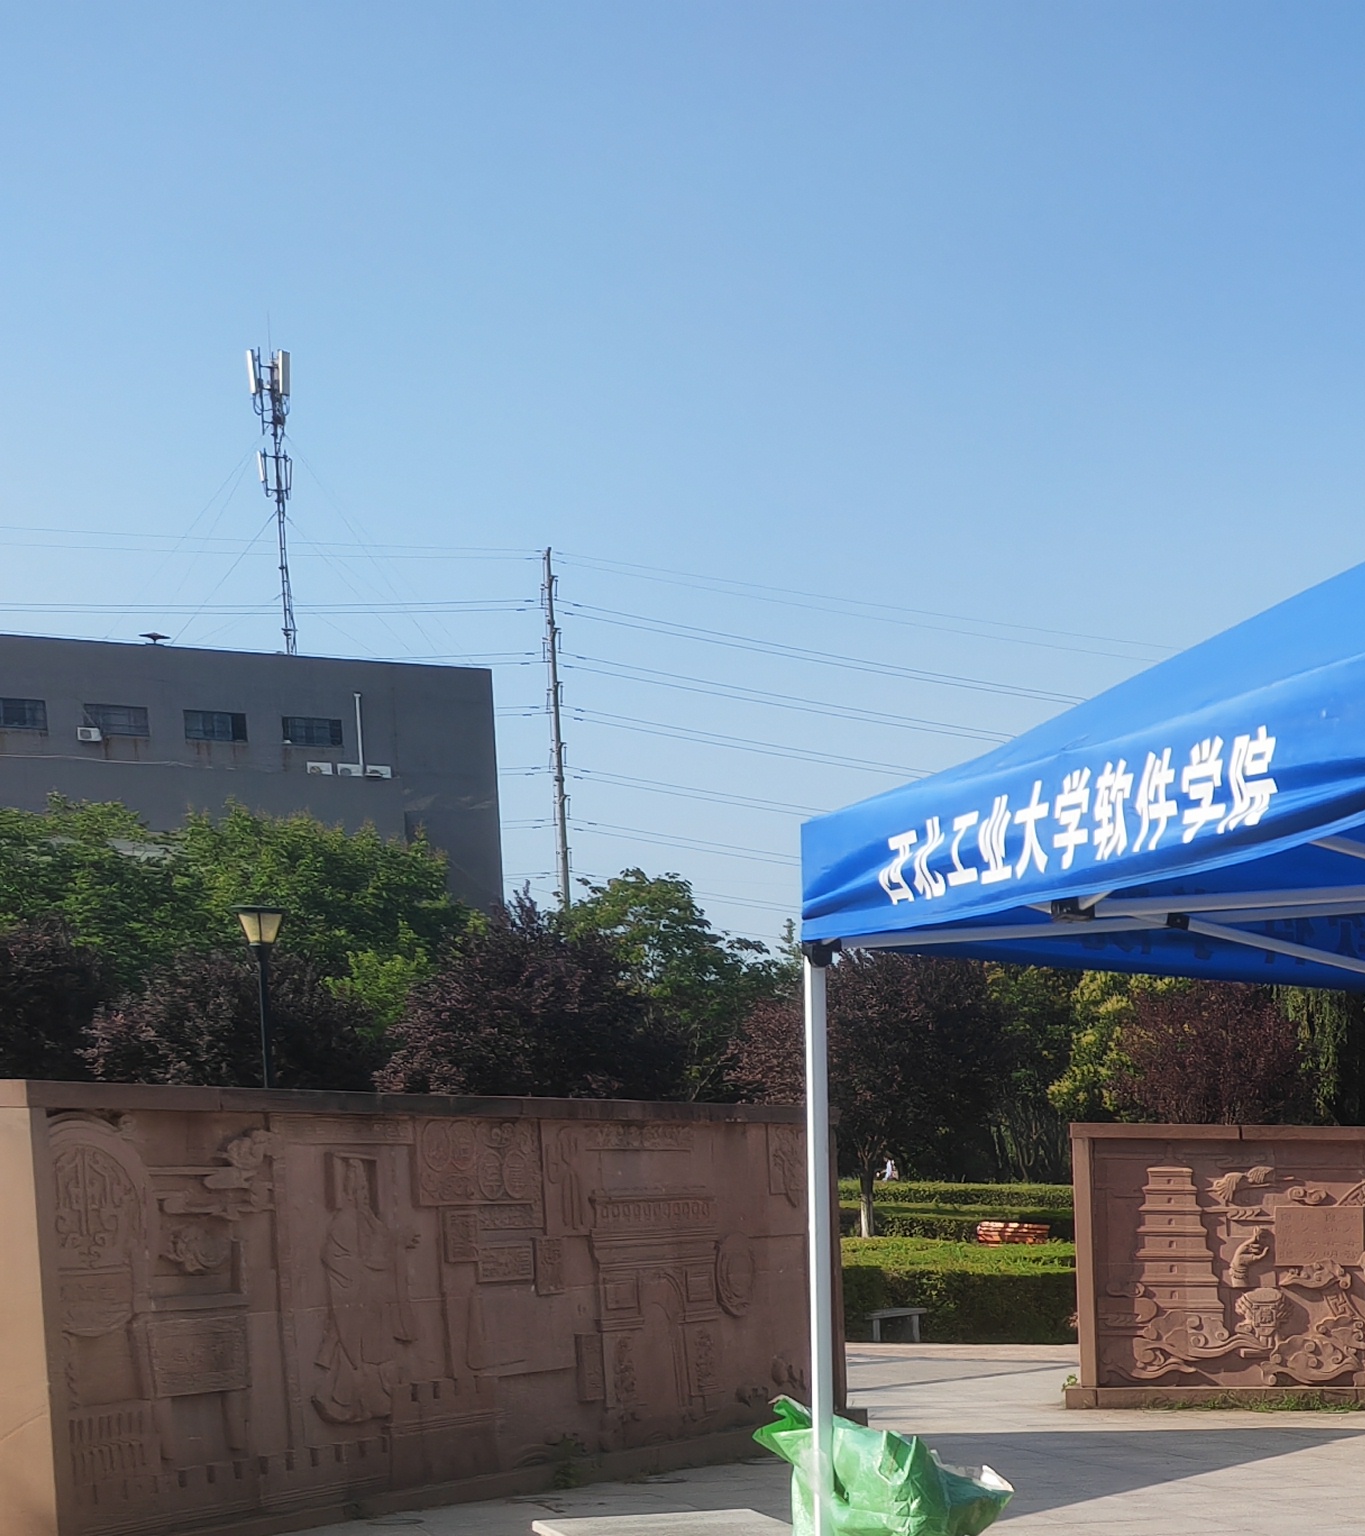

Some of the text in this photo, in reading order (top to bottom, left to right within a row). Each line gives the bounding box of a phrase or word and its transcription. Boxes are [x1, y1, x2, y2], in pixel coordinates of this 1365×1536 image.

[879, 726, 1278, 905] 西北工业大学软件学院
